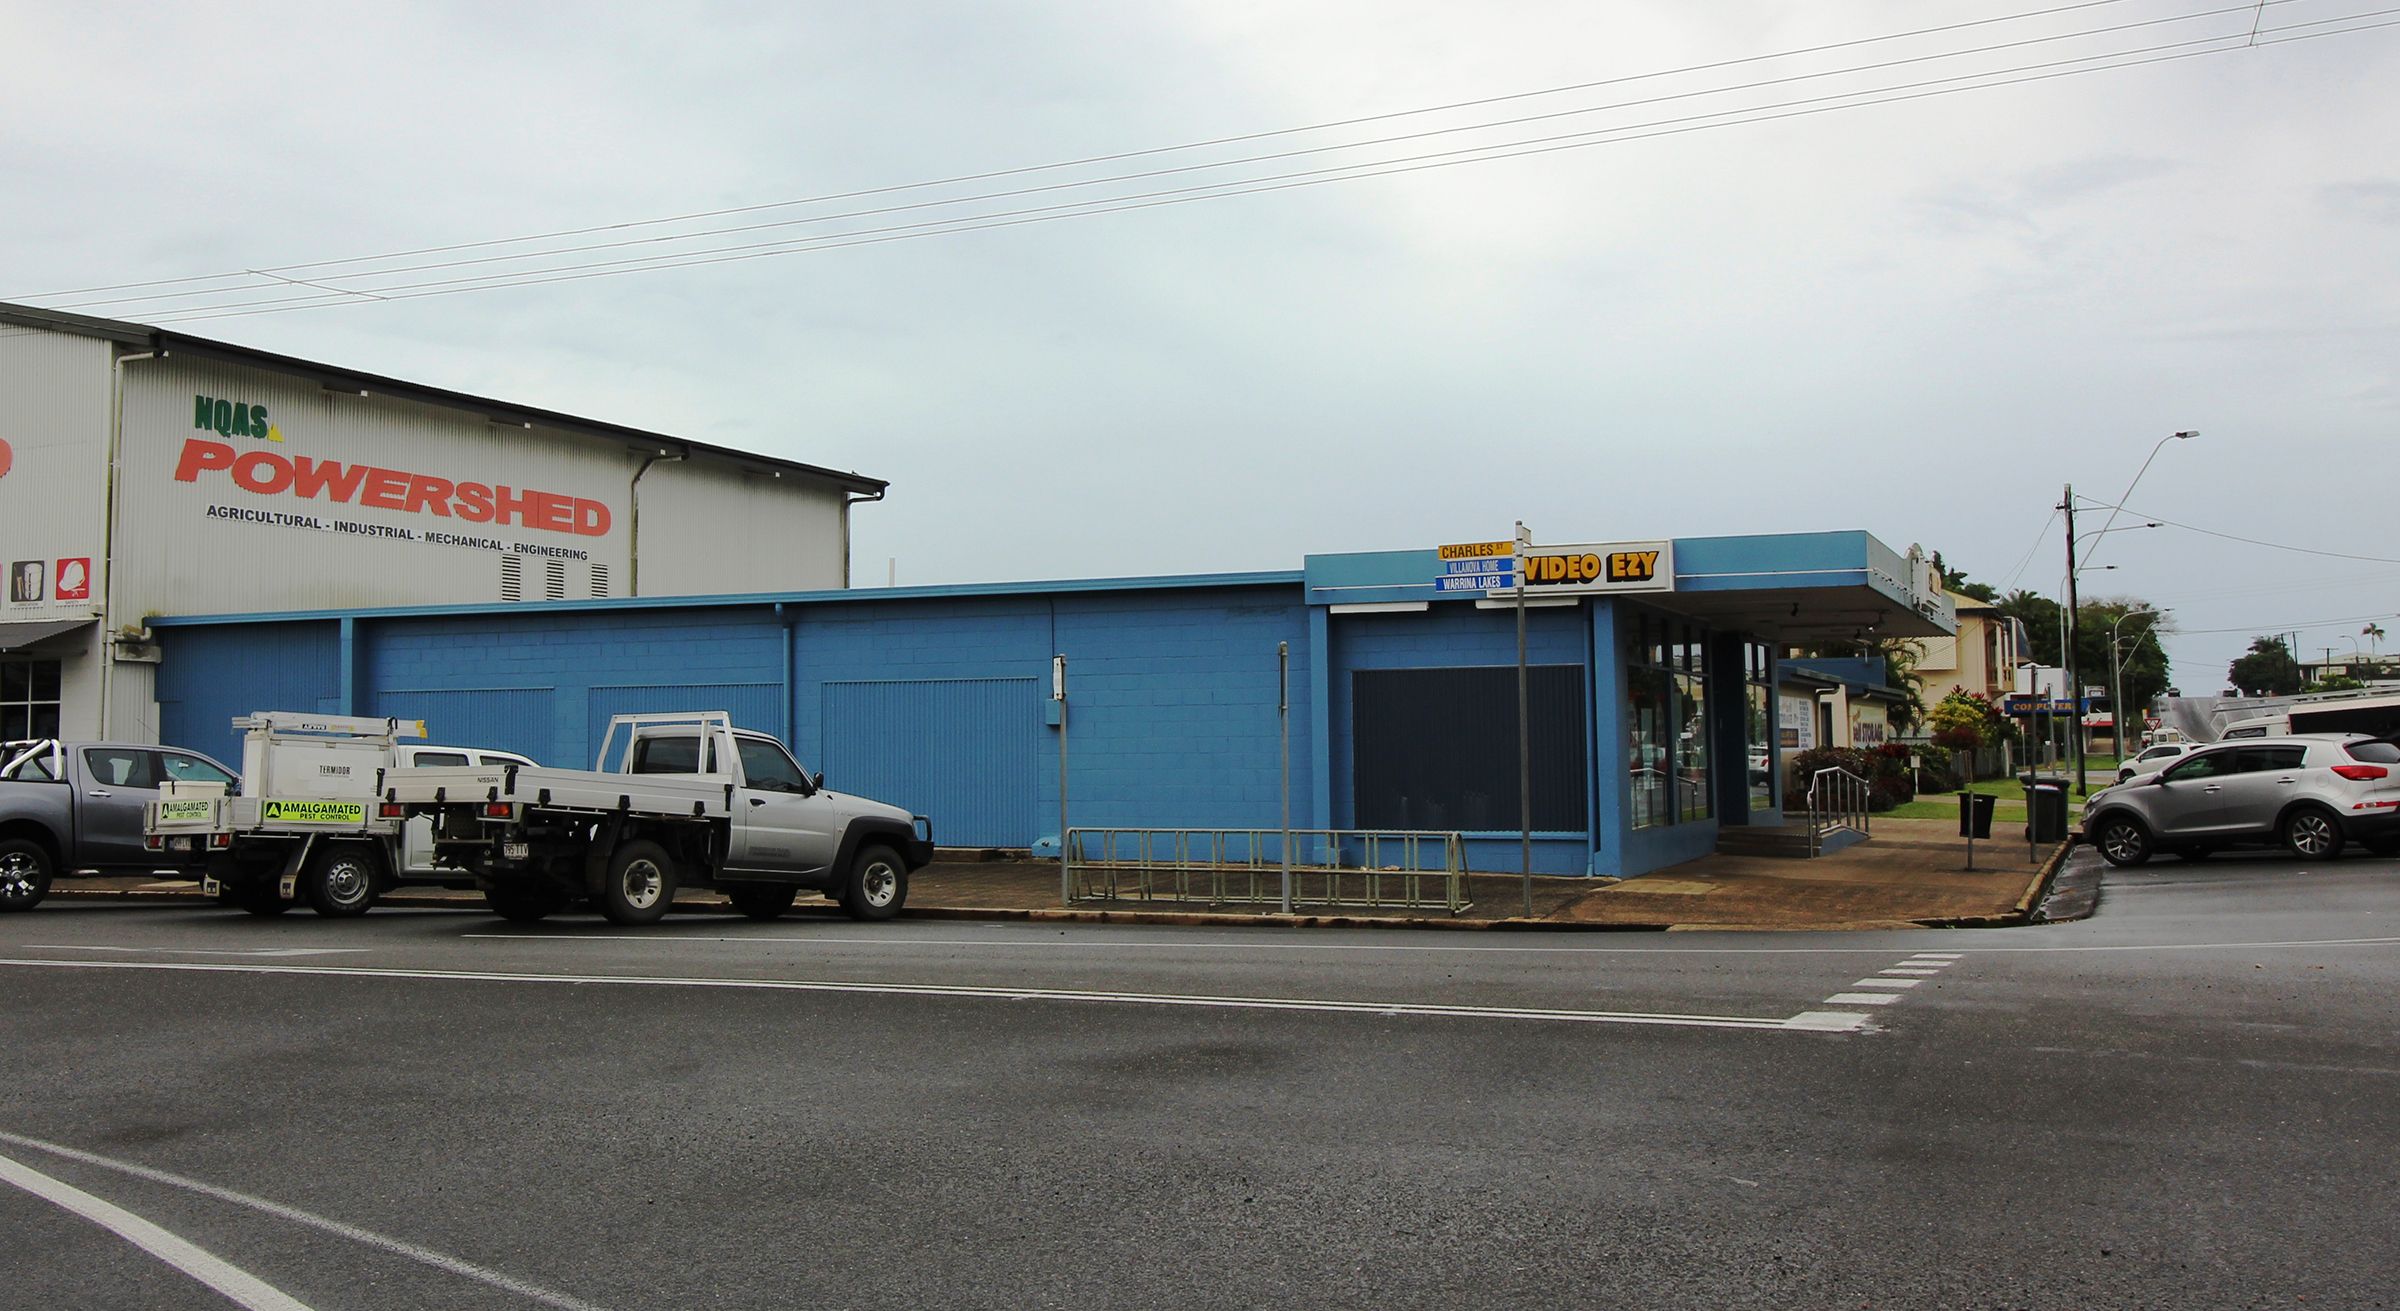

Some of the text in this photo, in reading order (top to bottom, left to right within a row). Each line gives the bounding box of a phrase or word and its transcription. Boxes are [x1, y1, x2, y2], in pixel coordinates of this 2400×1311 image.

[195, 395, 268, 439] NQAS
[174, 438, 612, 538] POWERSHED
[207, 505, 322, 529] AGRICULTURAL
[334, 520, 414, 540] INDUSTRIAL
[425, 532, 504, 550] MECHANICAL
[514, 543, 588, 561] ENGINEERING
[1442, 543, 1493, 559] CHARLES
[1449, 560, 1499, 574] VILLANOVA HOME
[1523, 550, 1660, 585] VIDEO EZY
[1443, 575, 1501, 590] WARRINA LAKES
[320, 765, 351, 775] TERMIDOR
[169, 801, 208, 812] AMALGAMATED
[283, 803, 361, 815] AMALGAMATED
